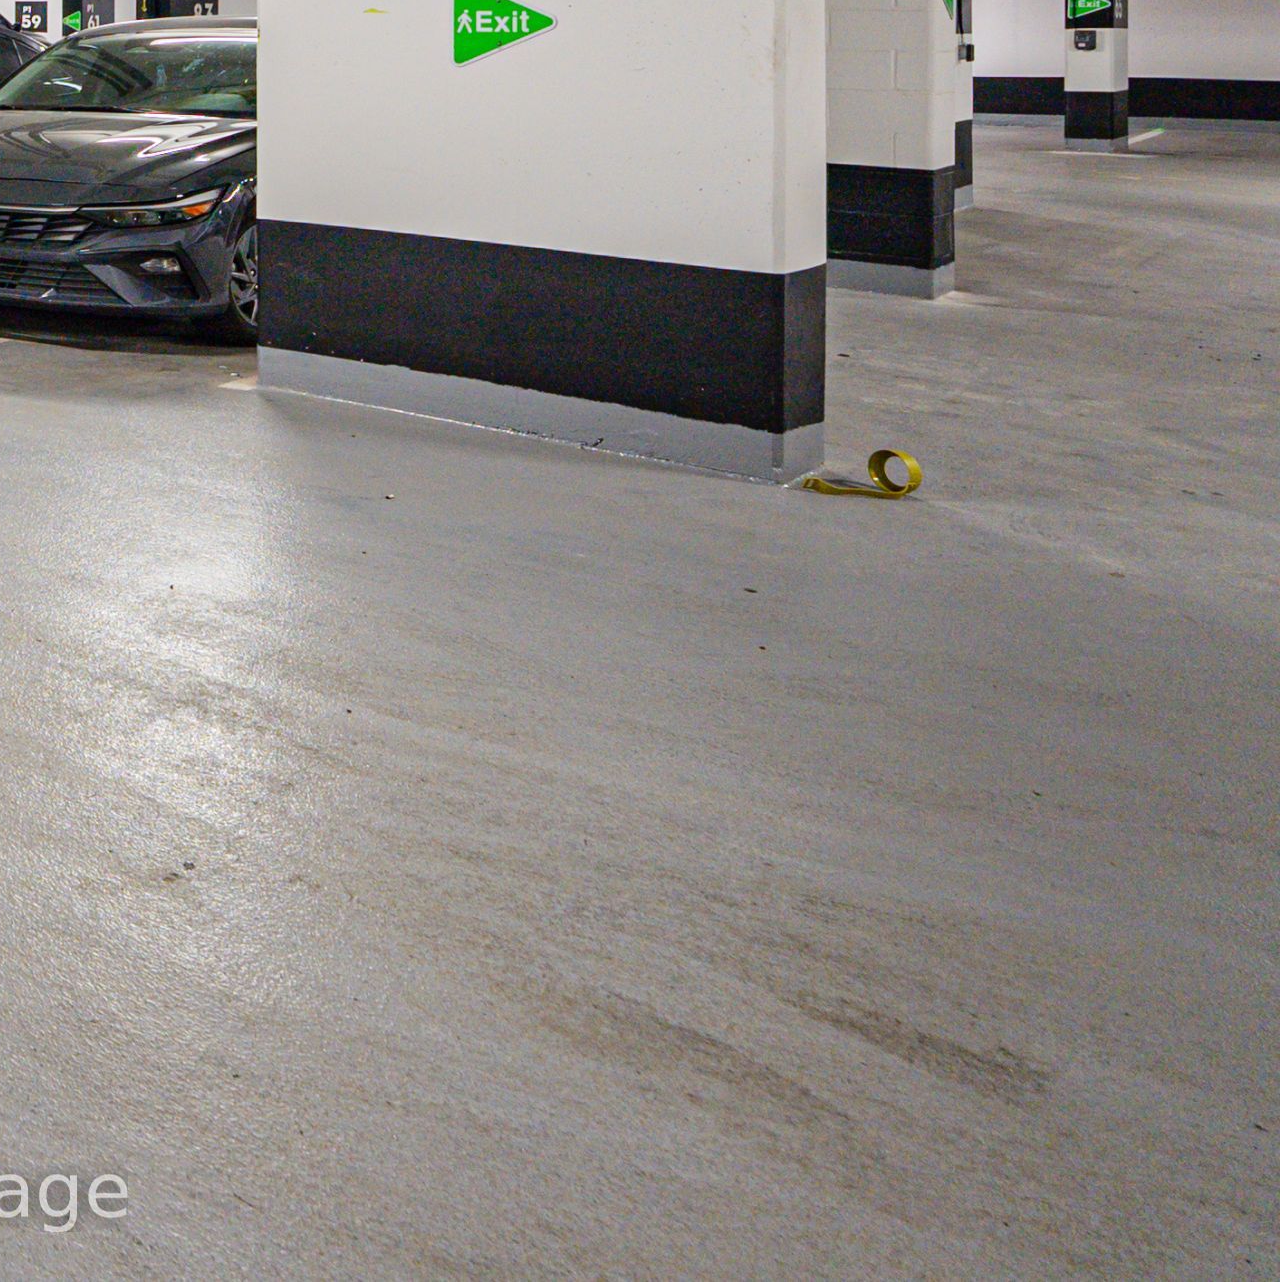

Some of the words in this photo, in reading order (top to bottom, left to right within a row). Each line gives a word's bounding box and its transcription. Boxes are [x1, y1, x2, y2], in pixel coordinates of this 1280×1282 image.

[22, 5, 32, 14] P1
[1077, 0, 1101, 8] Exit
[21, 14, 42, 29] 59
[87, 14, 100, 29] 61
[475, 10, 530, 33] Exit
